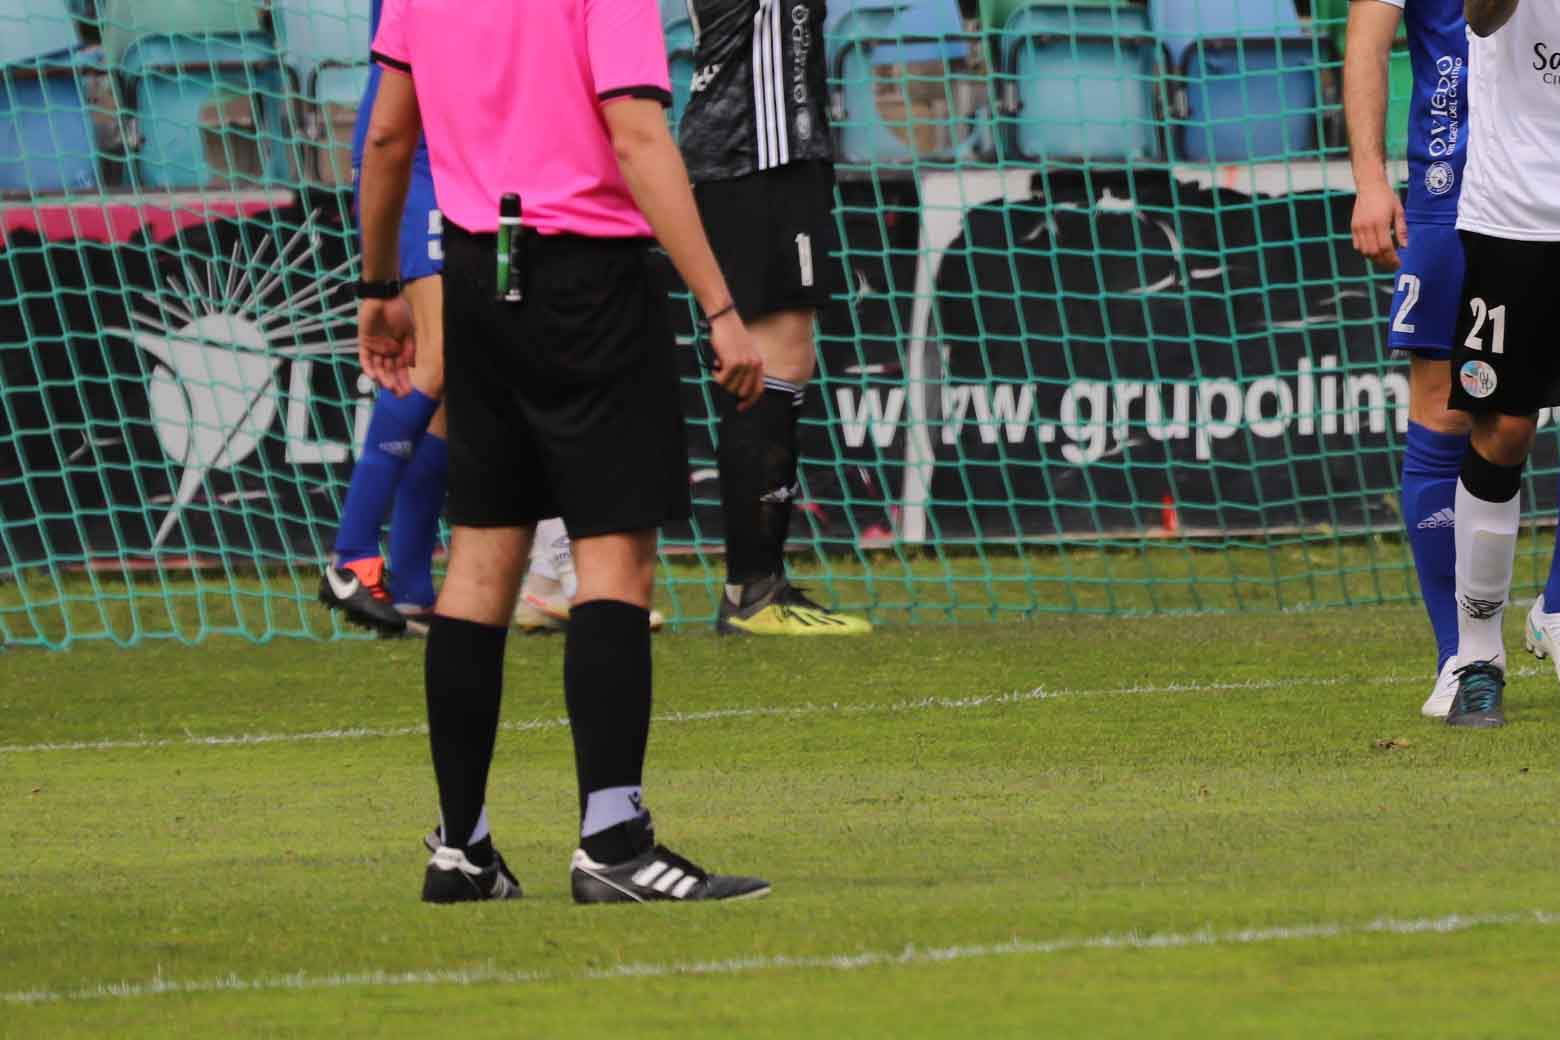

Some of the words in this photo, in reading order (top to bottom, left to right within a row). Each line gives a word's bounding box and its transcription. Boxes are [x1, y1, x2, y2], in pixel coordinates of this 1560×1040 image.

[1428, 55, 1453, 157] OVIEDO
[794, 232, 814, 287] 1
[1391, 273, 1421, 334] 2
[1463, 296, 1506, 354] 21
